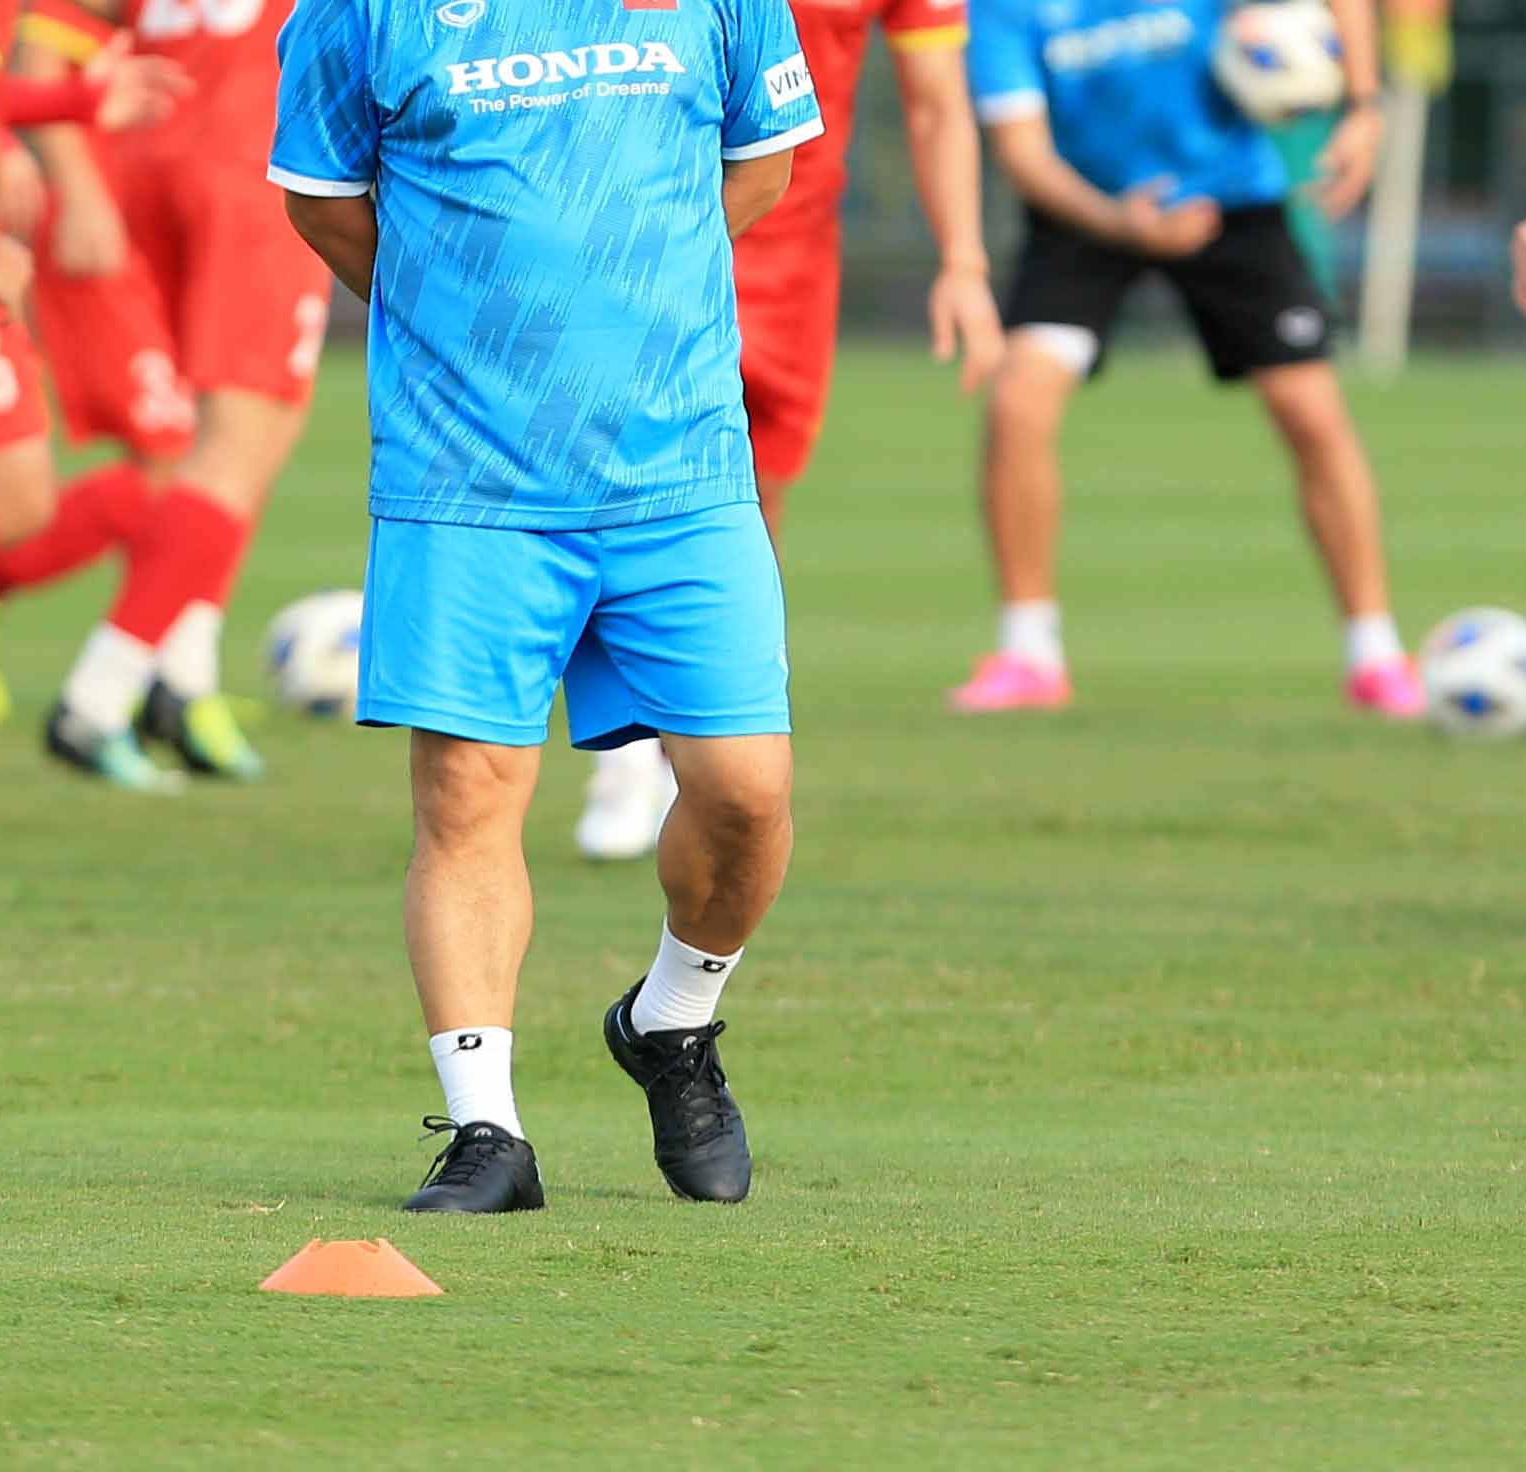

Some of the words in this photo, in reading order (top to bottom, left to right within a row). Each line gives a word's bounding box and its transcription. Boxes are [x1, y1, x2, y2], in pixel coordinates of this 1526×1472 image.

[446, 41, 687, 95] HONDA
[469, 98, 506, 114] The
[509, 92, 569, 110] Power
[572, 84, 591, 101] of
[595, 80, 671, 97] Dreams
